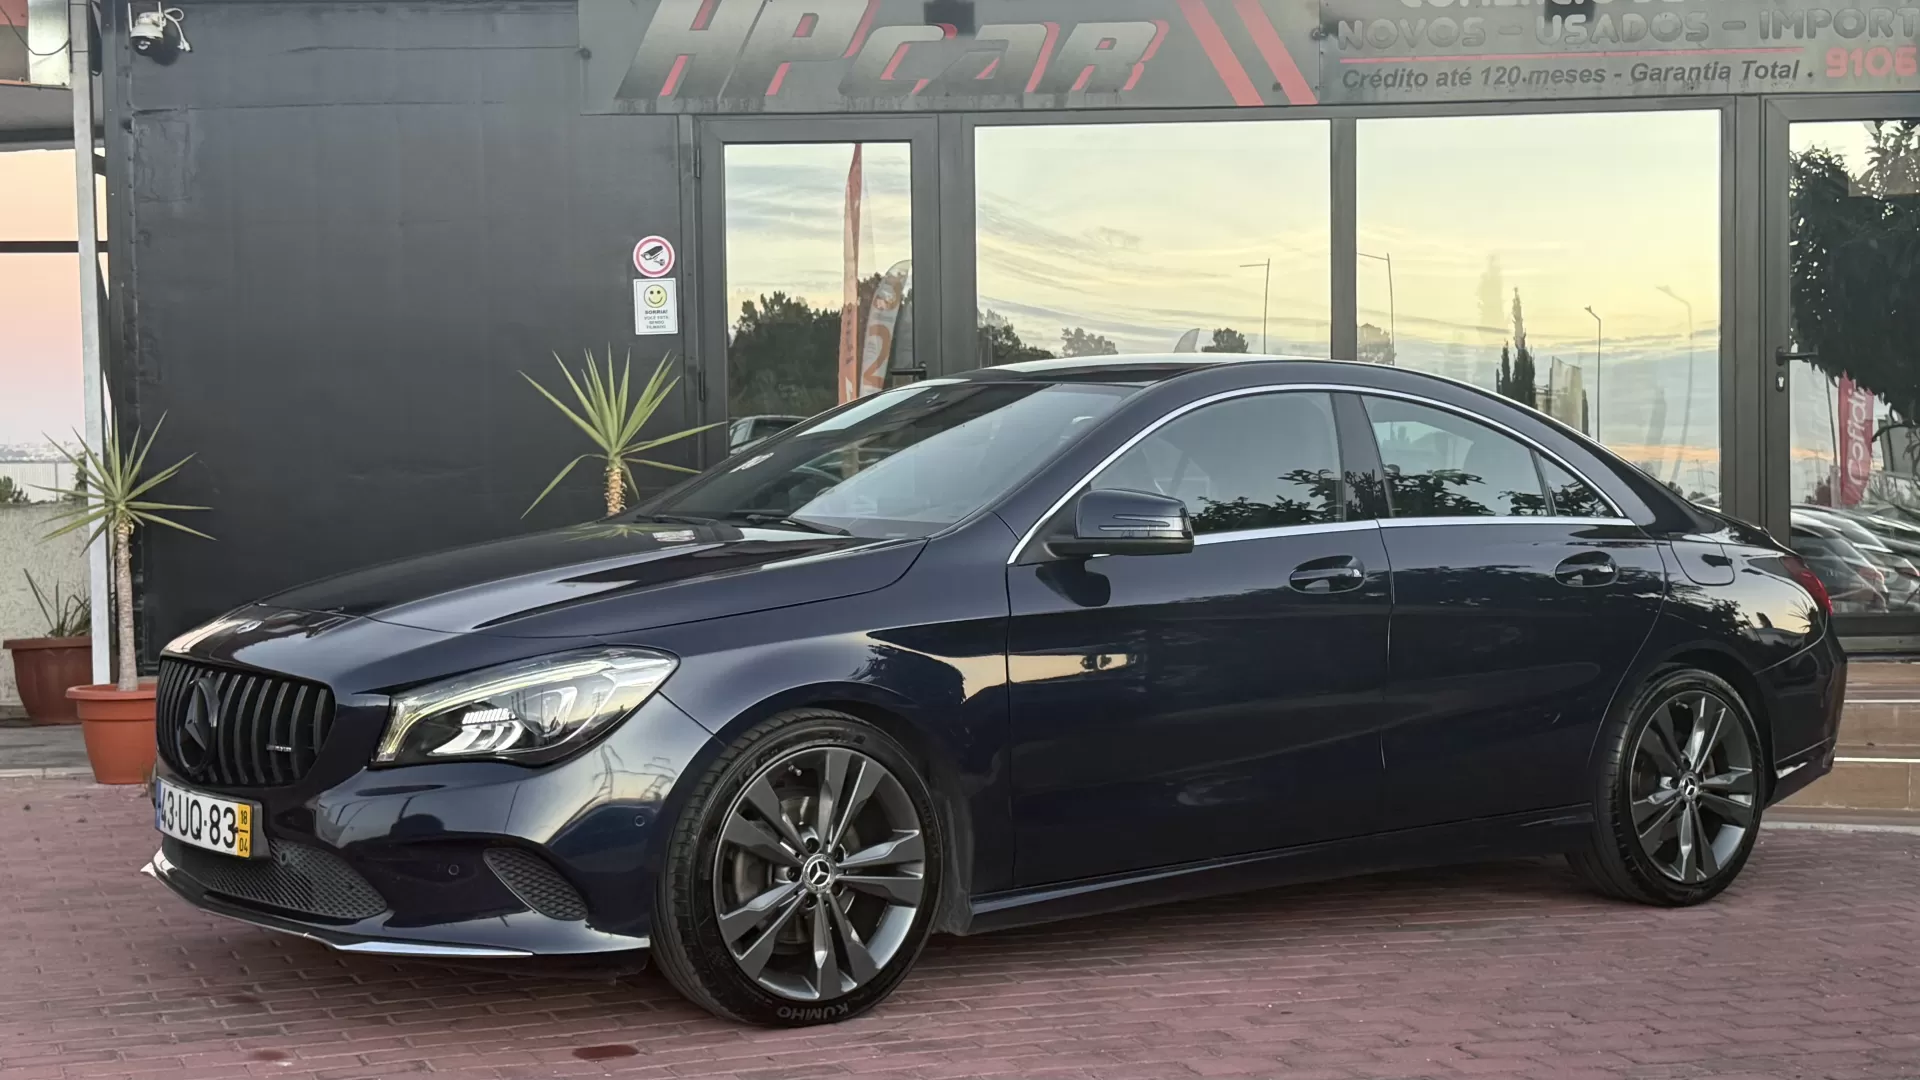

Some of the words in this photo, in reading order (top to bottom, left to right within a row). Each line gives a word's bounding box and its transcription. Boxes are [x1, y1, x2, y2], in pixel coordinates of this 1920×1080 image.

[1338, 17, 1486, 50] NOVOS
[1535, 12, 1709, 45] USADOS
[1759, 8, 1920, 39] IMPORT
[1342, 68, 1429, 90] Crédito
[1435, 67, 1472, 87] até
[1630, 61, 1731, 83] Garantia
[777, 1002, 849, 1020] KUMHO
